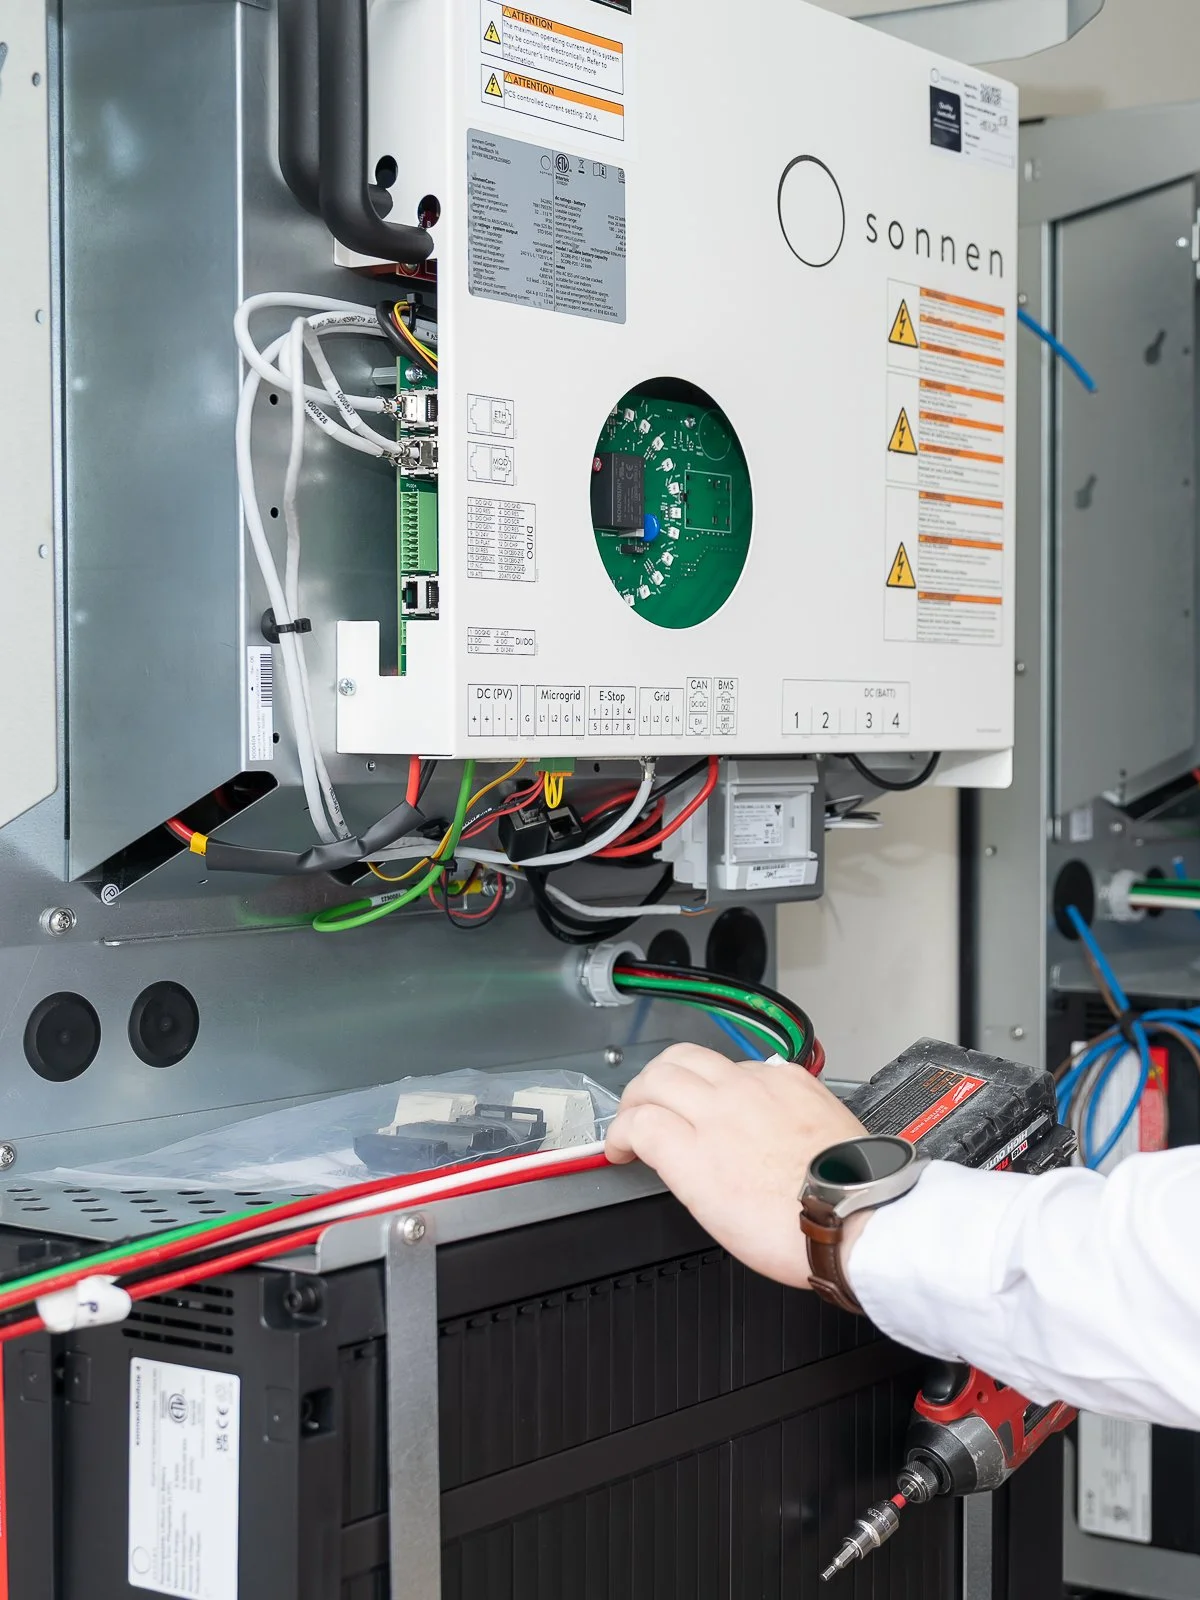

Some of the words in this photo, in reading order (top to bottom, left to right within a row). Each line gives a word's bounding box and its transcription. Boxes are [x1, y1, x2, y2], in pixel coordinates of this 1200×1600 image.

[512, 11, 553, 30] ATTENTION
[503, 20, 512, 29] The
[514, 25, 540, 38] maximum
[540, 34, 565, 47] operating
[566, 40, 584, 52] current
[592, 49, 602, 57] this
[602, 52, 620, 62] system
[504, 32, 514, 41] may
[523, 38, 550, 51] controlled
[551, 46, 586, 62] electronically.
[587, 56, 600, 67] Refer
[504, 42, 543, 58] manufacturer's
[544, 54, 574, 68] instructions
[574, 62, 582, 70] for
[583, 66, 596, 76] more
[504, 52, 535, 66] information.
[514, 77, 554, 96] ATTENTION
[504, 89, 516, 98] PCS
[516, 94, 544, 106] controlled
[545, 102, 564, 113] current
[565, 107, 584, 119] setting:
[585, 112, 592, 120] 20
[866, 214, 1003, 278] sonnen
[495, 410, 506, 419] ETH
[691, 680, 707, 690] CAN
[719, 680, 734, 690] BMS
[864, 688, 874, 698] DC
[876, 688, 896, 698] (BATT)
[477, 688, 491, 699] DC
[494, 688, 512, 700] (PV)
[540, 690, 580, 702] Microgrid
[600, 690, 625, 704] E-Stop
[654, 691, 670, 701] Grid
[794, 712, 799, 728] 1
[822, 712, 829, 728] 2
[866, 712, 873, 728] 3
[892, 713, 900, 728] 4
[1008, 1130, 1028, 1152] HIGH
[1012, 1141, 1028, 1160] M18
